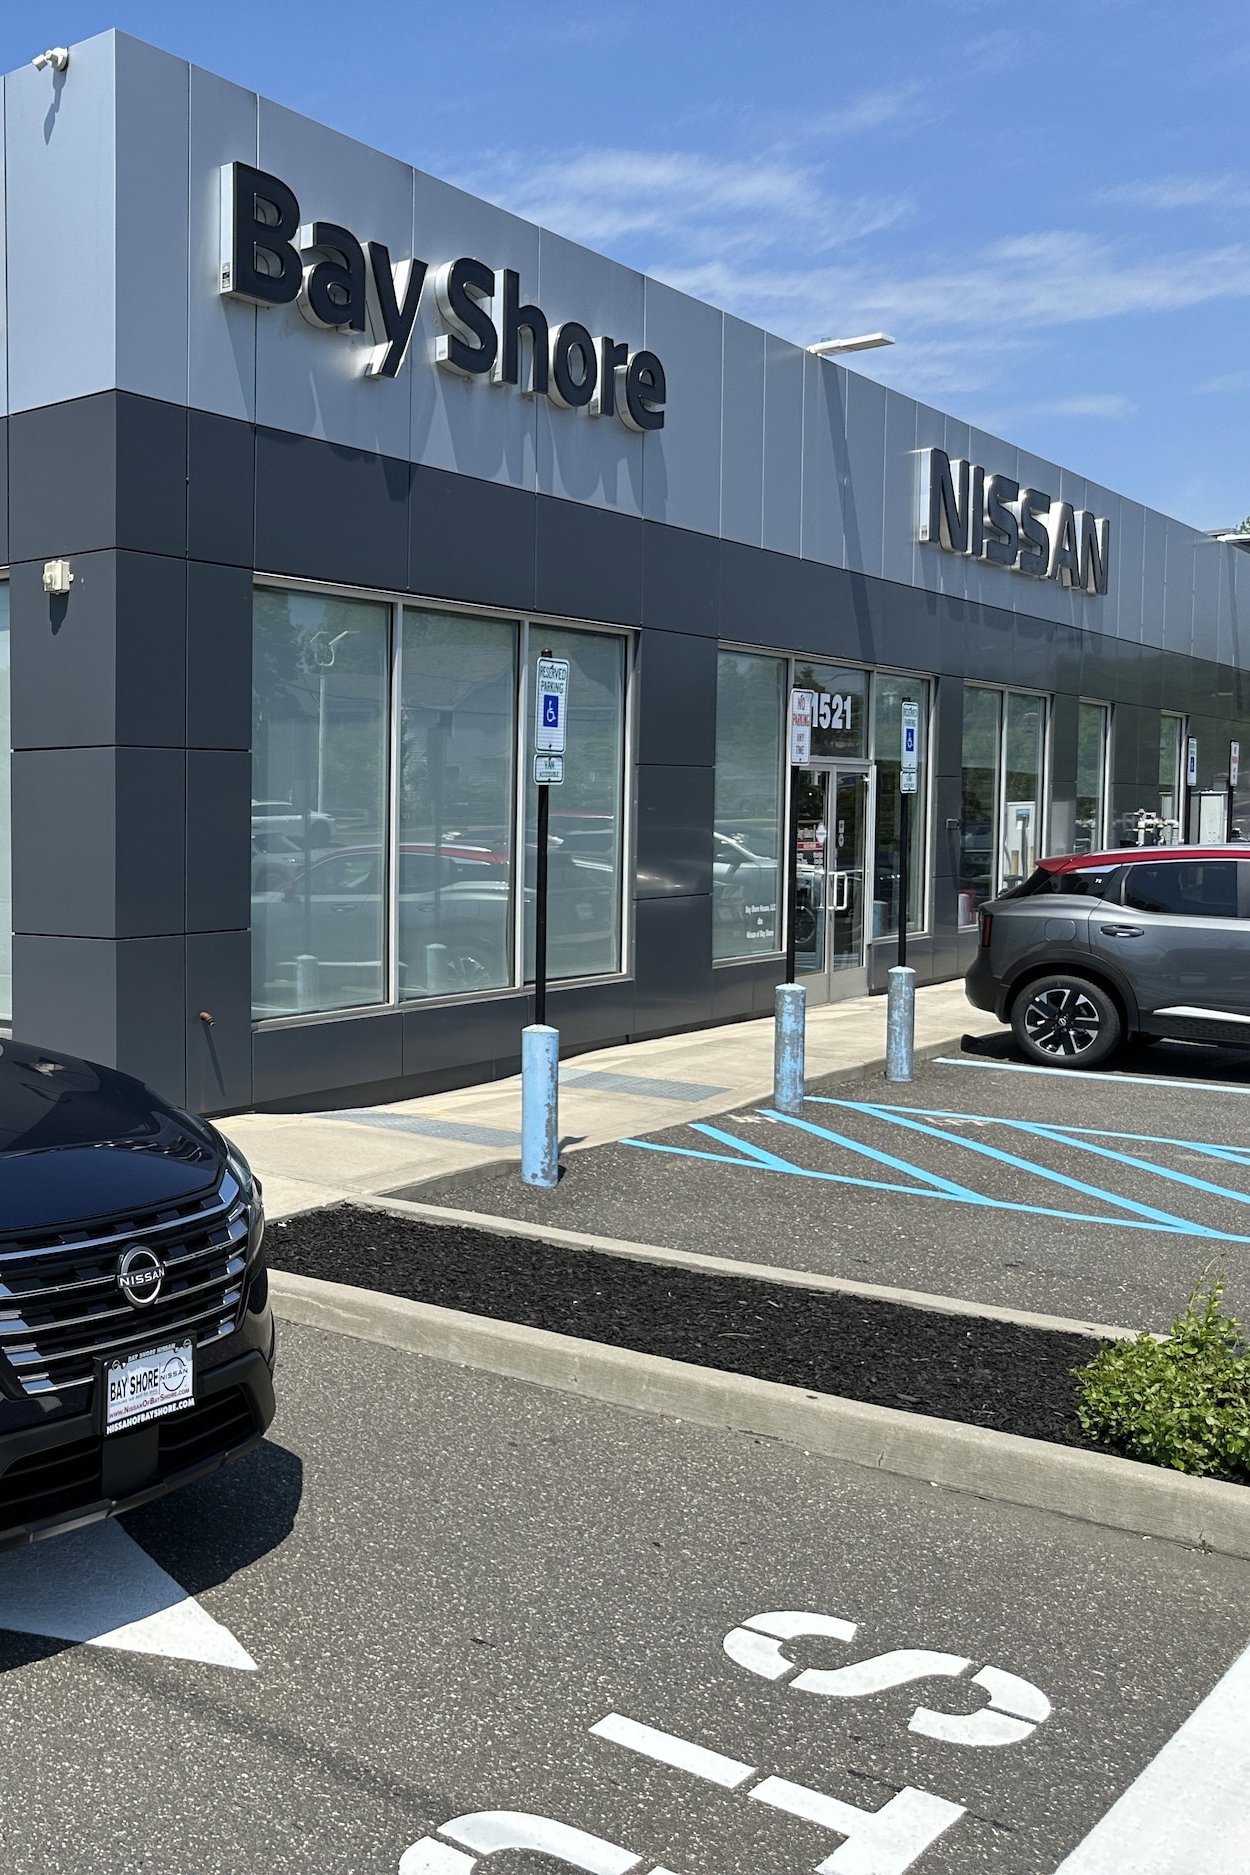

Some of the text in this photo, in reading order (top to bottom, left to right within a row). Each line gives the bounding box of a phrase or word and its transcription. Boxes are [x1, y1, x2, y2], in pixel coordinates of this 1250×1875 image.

[220, 161, 667, 431] Bay Shore
[919, 448, 1110, 595] NISSAN
[540, 665, 567, 681] RESERVED
[540, 681, 564, 694] PARKING
[797, 696, 806, 711] NO
[811, 692, 852, 730] 1521
[792, 713, 810, 727] PARKING
[119, 1267, 165, 1287] NISSAN
[110, 1378, 128, 1401] BAY
[129, 1368, 159, 1395] SHORE
[160, 1368, 188, 1381] NISSAN
[106, 1397, 195, 1435] NISSANOFBAYSHORE.COM
